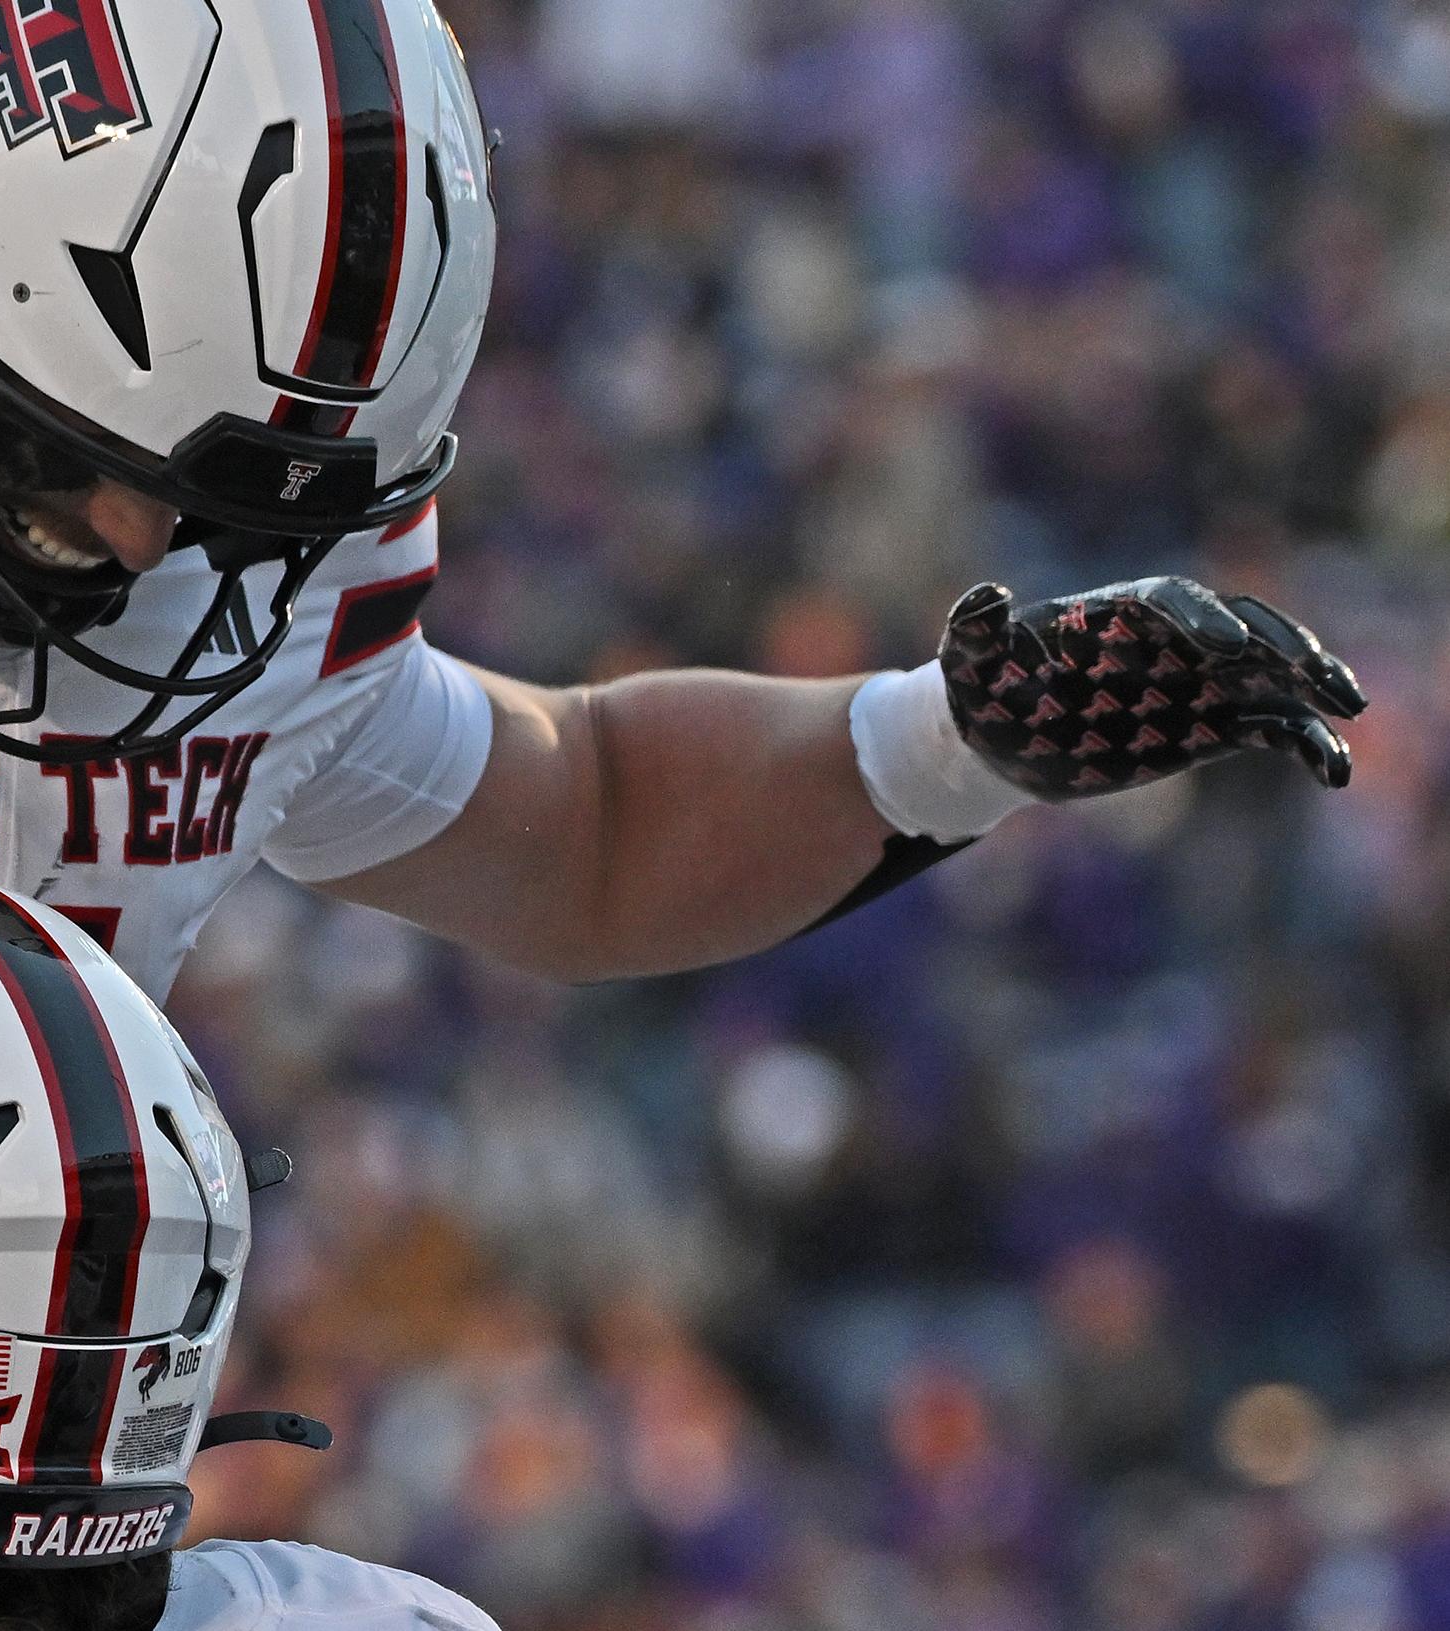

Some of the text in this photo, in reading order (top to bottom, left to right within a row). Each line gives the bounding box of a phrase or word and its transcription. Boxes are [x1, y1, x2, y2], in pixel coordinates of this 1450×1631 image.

[39, 731, 271, 865] TECH
[174, 1345, 202, 1378] 806
[4, 1503, 175, 1556] RAIDERS
